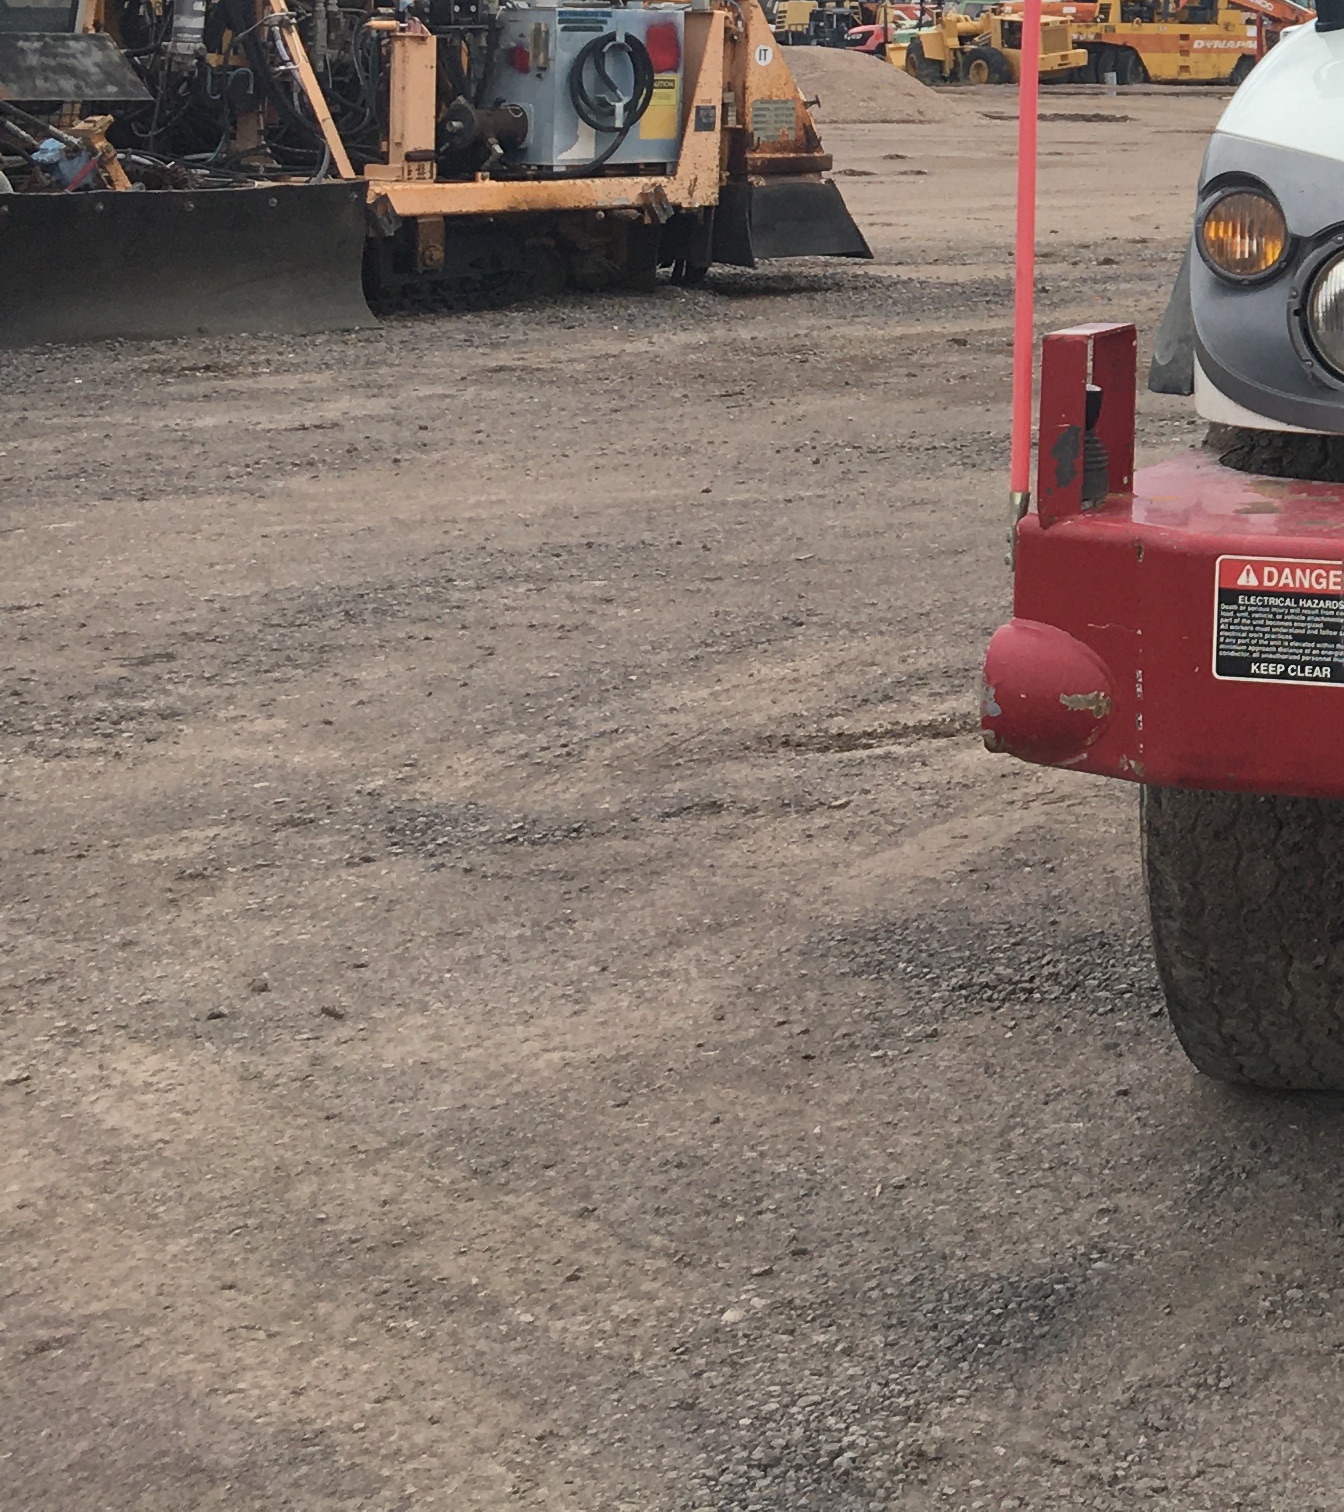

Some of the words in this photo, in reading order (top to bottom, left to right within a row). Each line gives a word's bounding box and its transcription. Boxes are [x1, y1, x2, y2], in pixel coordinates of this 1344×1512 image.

[1193, 39, 1258, 49] DYNAPA
[1238, 594, 1298, 608] ELECTRICAL
[1250, 662, 1286, 676] KEEP
[1287, 664, 1331, 678] CLEAR
